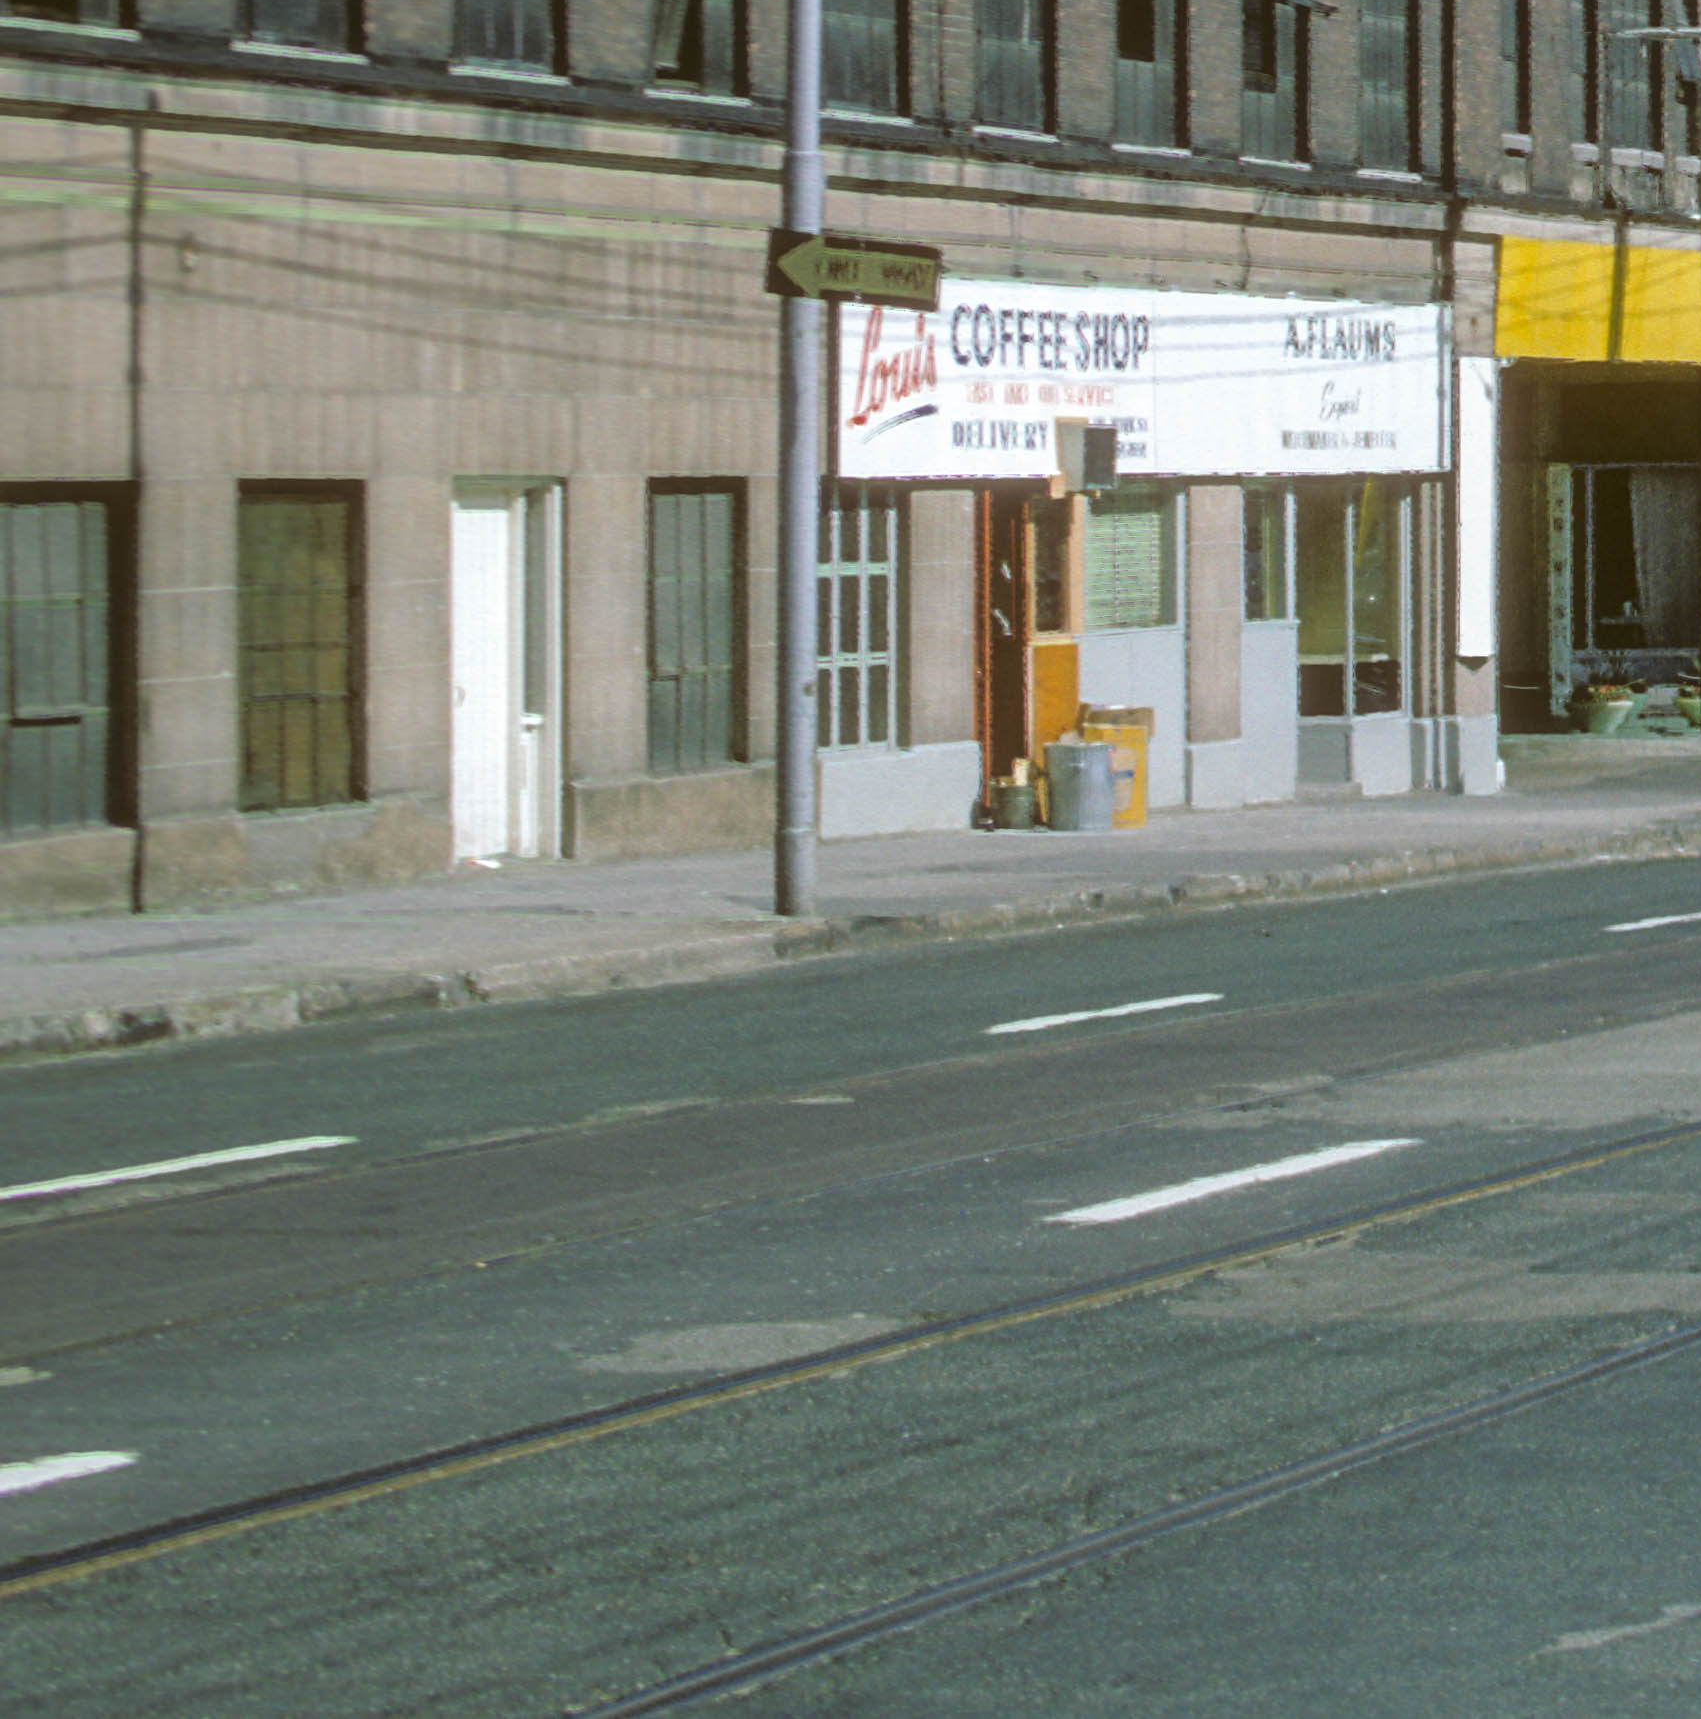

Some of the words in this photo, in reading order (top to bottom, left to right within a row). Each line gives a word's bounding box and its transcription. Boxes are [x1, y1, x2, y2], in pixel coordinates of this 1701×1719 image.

[950, 303, 1067, 370] COFFEE
[1073, 310, 1150, 372] SHOP
[952, 420, 1048, 451] DELIVERY
